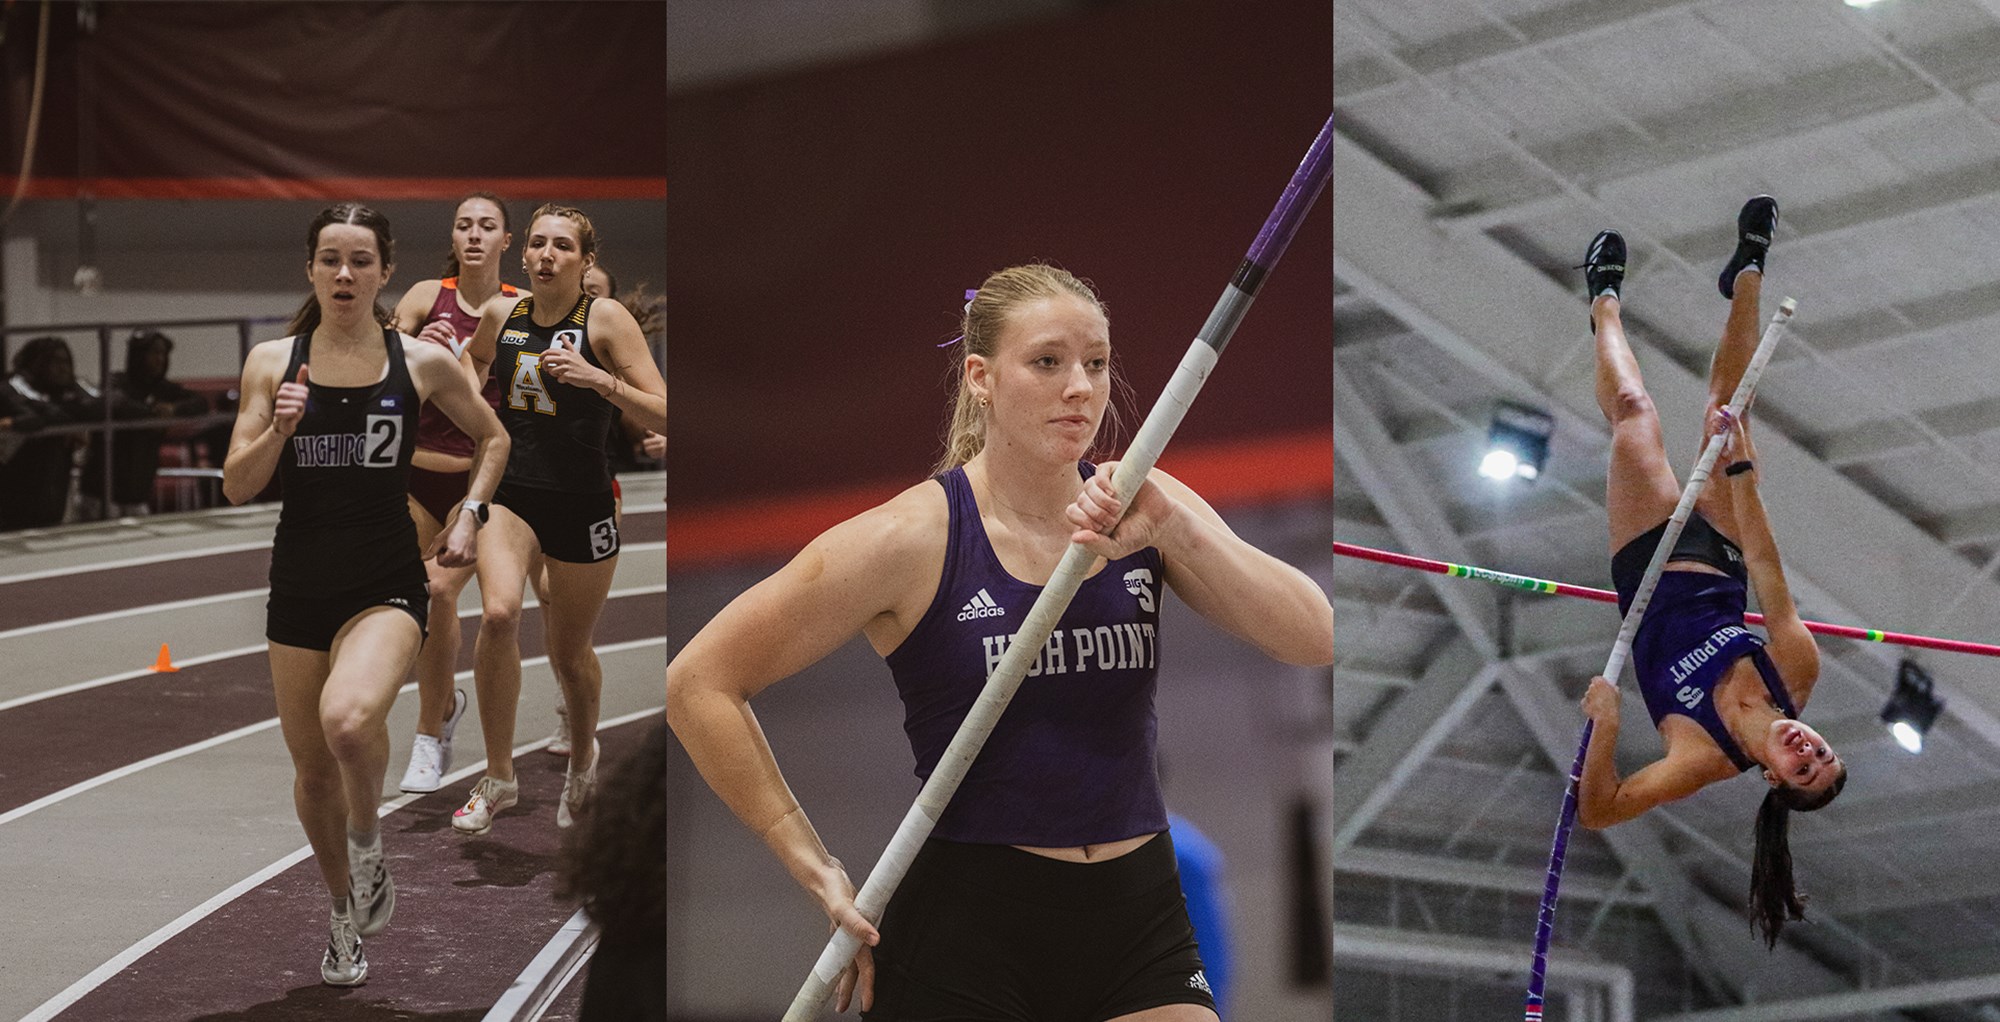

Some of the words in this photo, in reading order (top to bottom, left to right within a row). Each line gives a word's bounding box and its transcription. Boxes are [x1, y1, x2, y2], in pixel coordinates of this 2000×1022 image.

[508, 351, 556, 416] A
[293, 434, 341, 467] HIGH
[369, 418, 396, 464] 2
[594, 522, 614, 555] 3
[957, 605, 1005, 622] adidas
[982, 630, 1067, 681] HH
[1072, 623, 1155, 672] POINT
[1711, 625, 1752, 647] IGH
[1670, 640, 1719, 684] POINT
